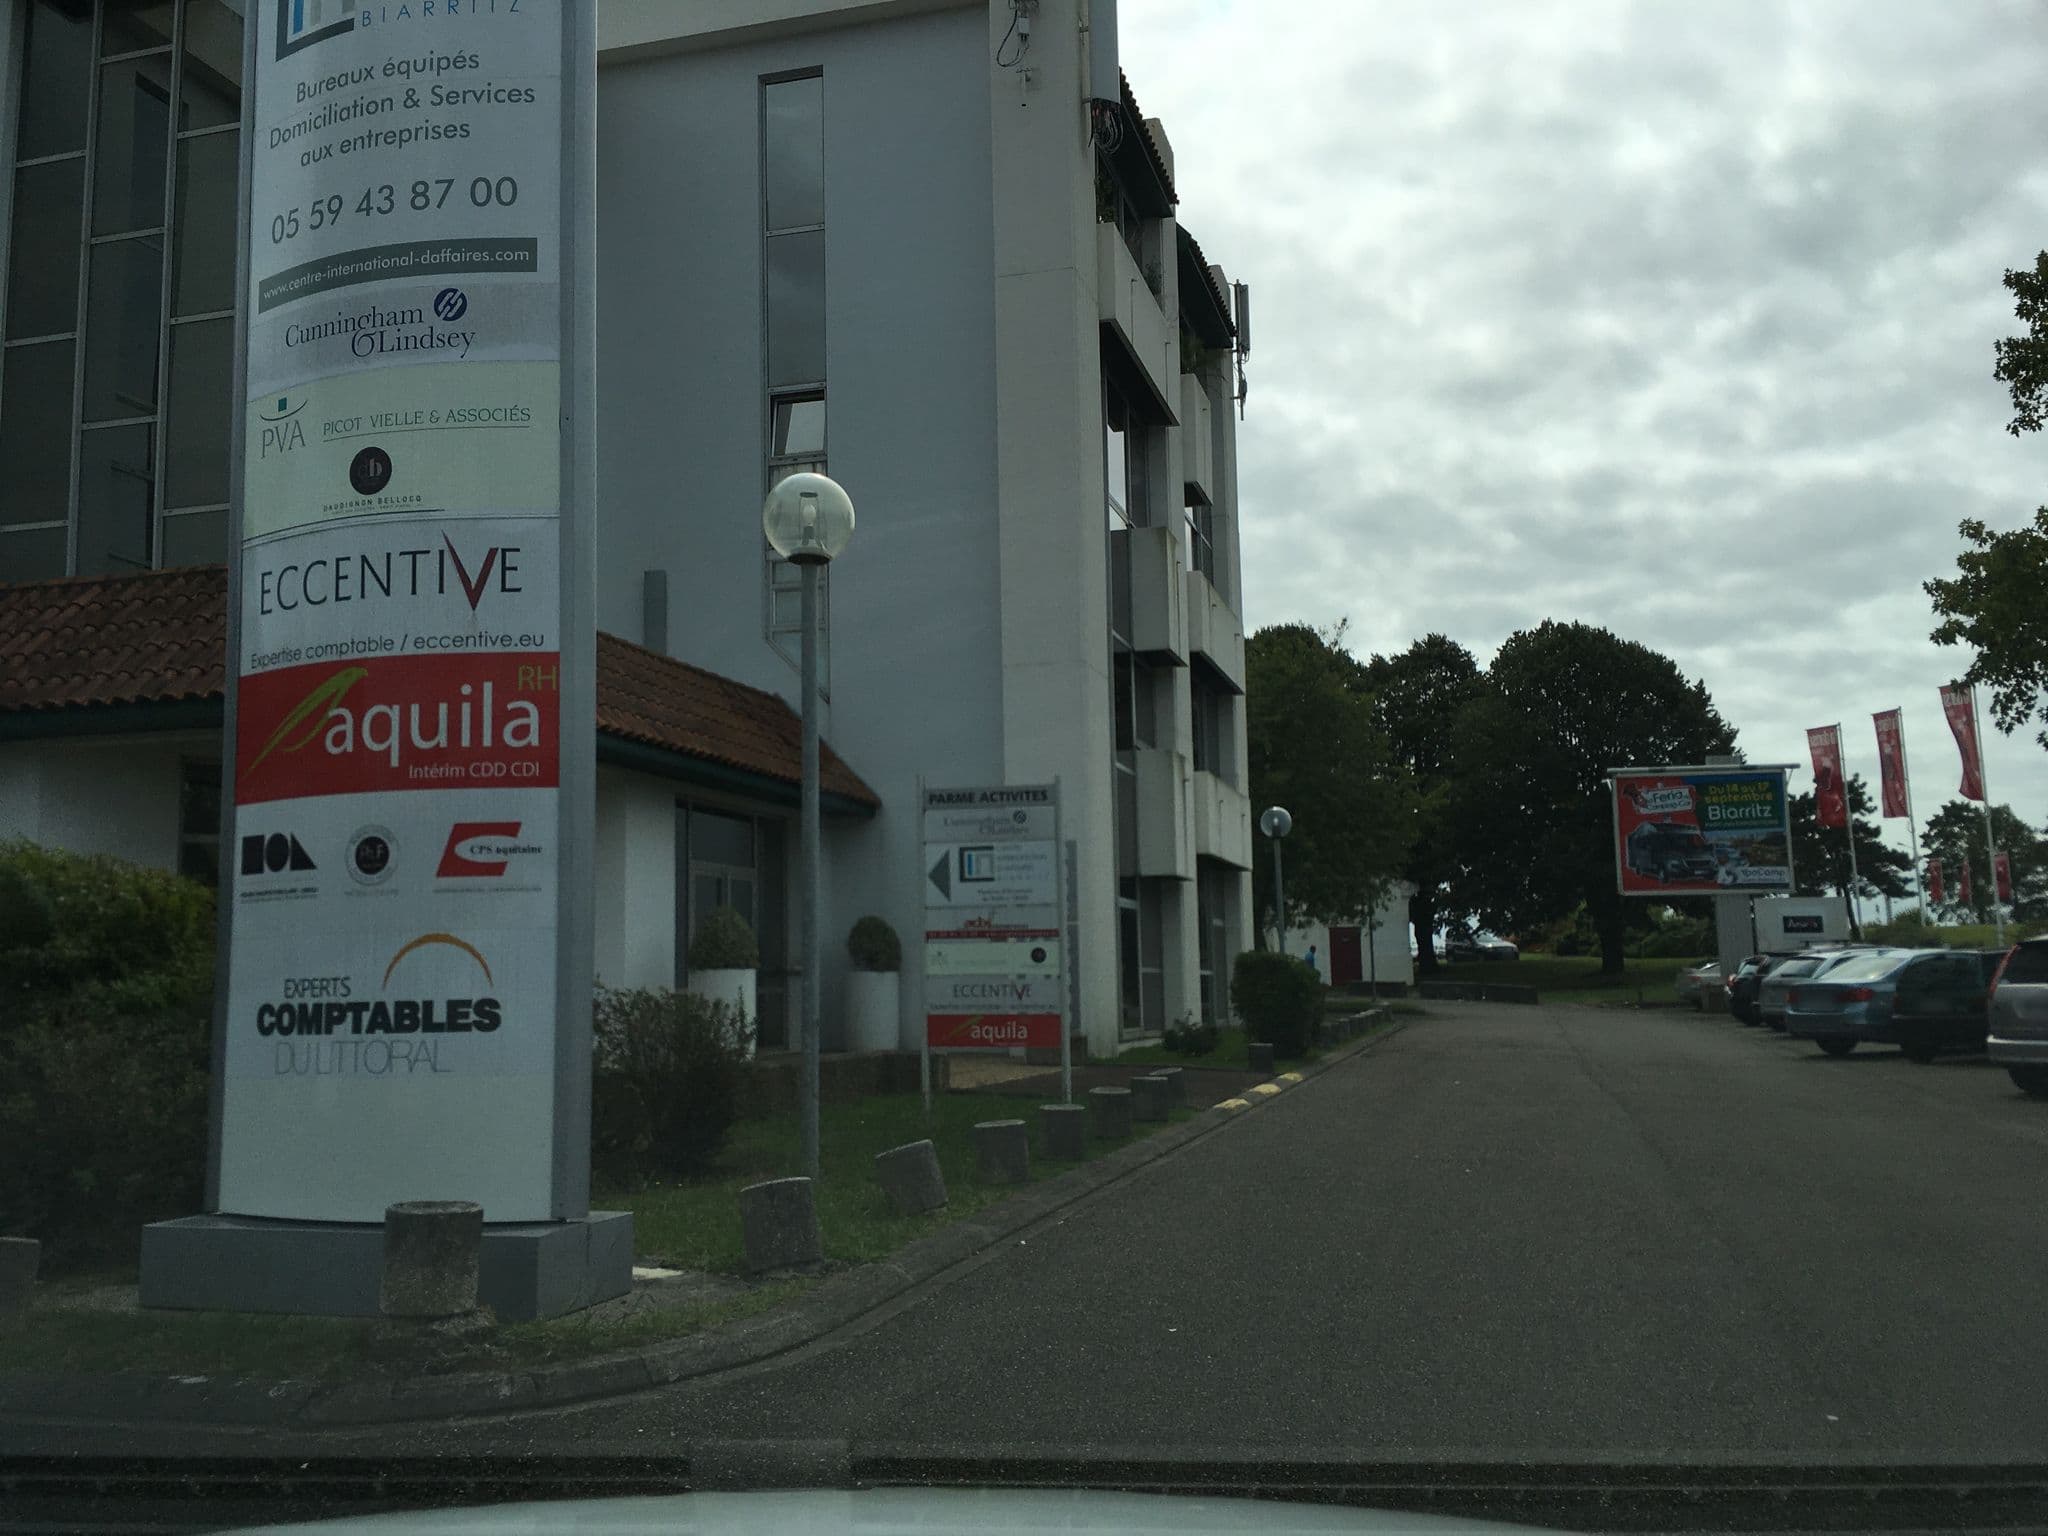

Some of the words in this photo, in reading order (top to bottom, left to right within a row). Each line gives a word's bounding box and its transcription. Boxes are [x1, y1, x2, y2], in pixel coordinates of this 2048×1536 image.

[296, 64, 375, 103] Bureaux
[382, 50, 481, 79] équipés
[270, 94, 394, 149] Domiciliation
[403, 87, 421, 110] &
[430, 82, 536, 107] Services
[300, 142, 333, 168] aux
[340, 119, 471, 154] entreprises
[272, 208, 299, 244] 05
[309, 195, 343, 231] 59
[355, 184, 395, 217] 43
[410, 178, 455, 210] 87
[470, 176, 518, 207] 00
[263, 248, 530, 300] www.centre-international-daffaires.com
[285, 306, 424, 348] Cunningham
[260, 419, 306, 459] PVA
[323, 416, 363, 436] PICOT
[370, 411, 424, 428] VIELLE
[429, 410, 440, 423] &
[445, 405, 532, 423] ASSOCIÉS
[260, 529, 522, 615] ECCENTIVE
[251, 647, 301, 670] Expertise
[305, 635, 394, 660] comptable
[399, 634, 408, 650] /
[413, 630, 545, 649] eccentive.eu
[517, 665, 557, 690] RH
[324, 681, 541, 768] aquila
[469, 762, 506, 777] CDD
[511, 762, 540, 777] CDI
[929, 792, 975, 805] PARME
[979, 789, 1049, 803] ACTIVITES
[1708, 803, 1773, 820] Biarritz
[283, 976, 351, 999] EXPERTS
[257, 998, 502, 1037] COMPTABLES
[971, 1021, 1028, 1043] aquila
[274, 1041, 311, 1076] DU
[315, 1039, 454, 1076] LITTORAL
